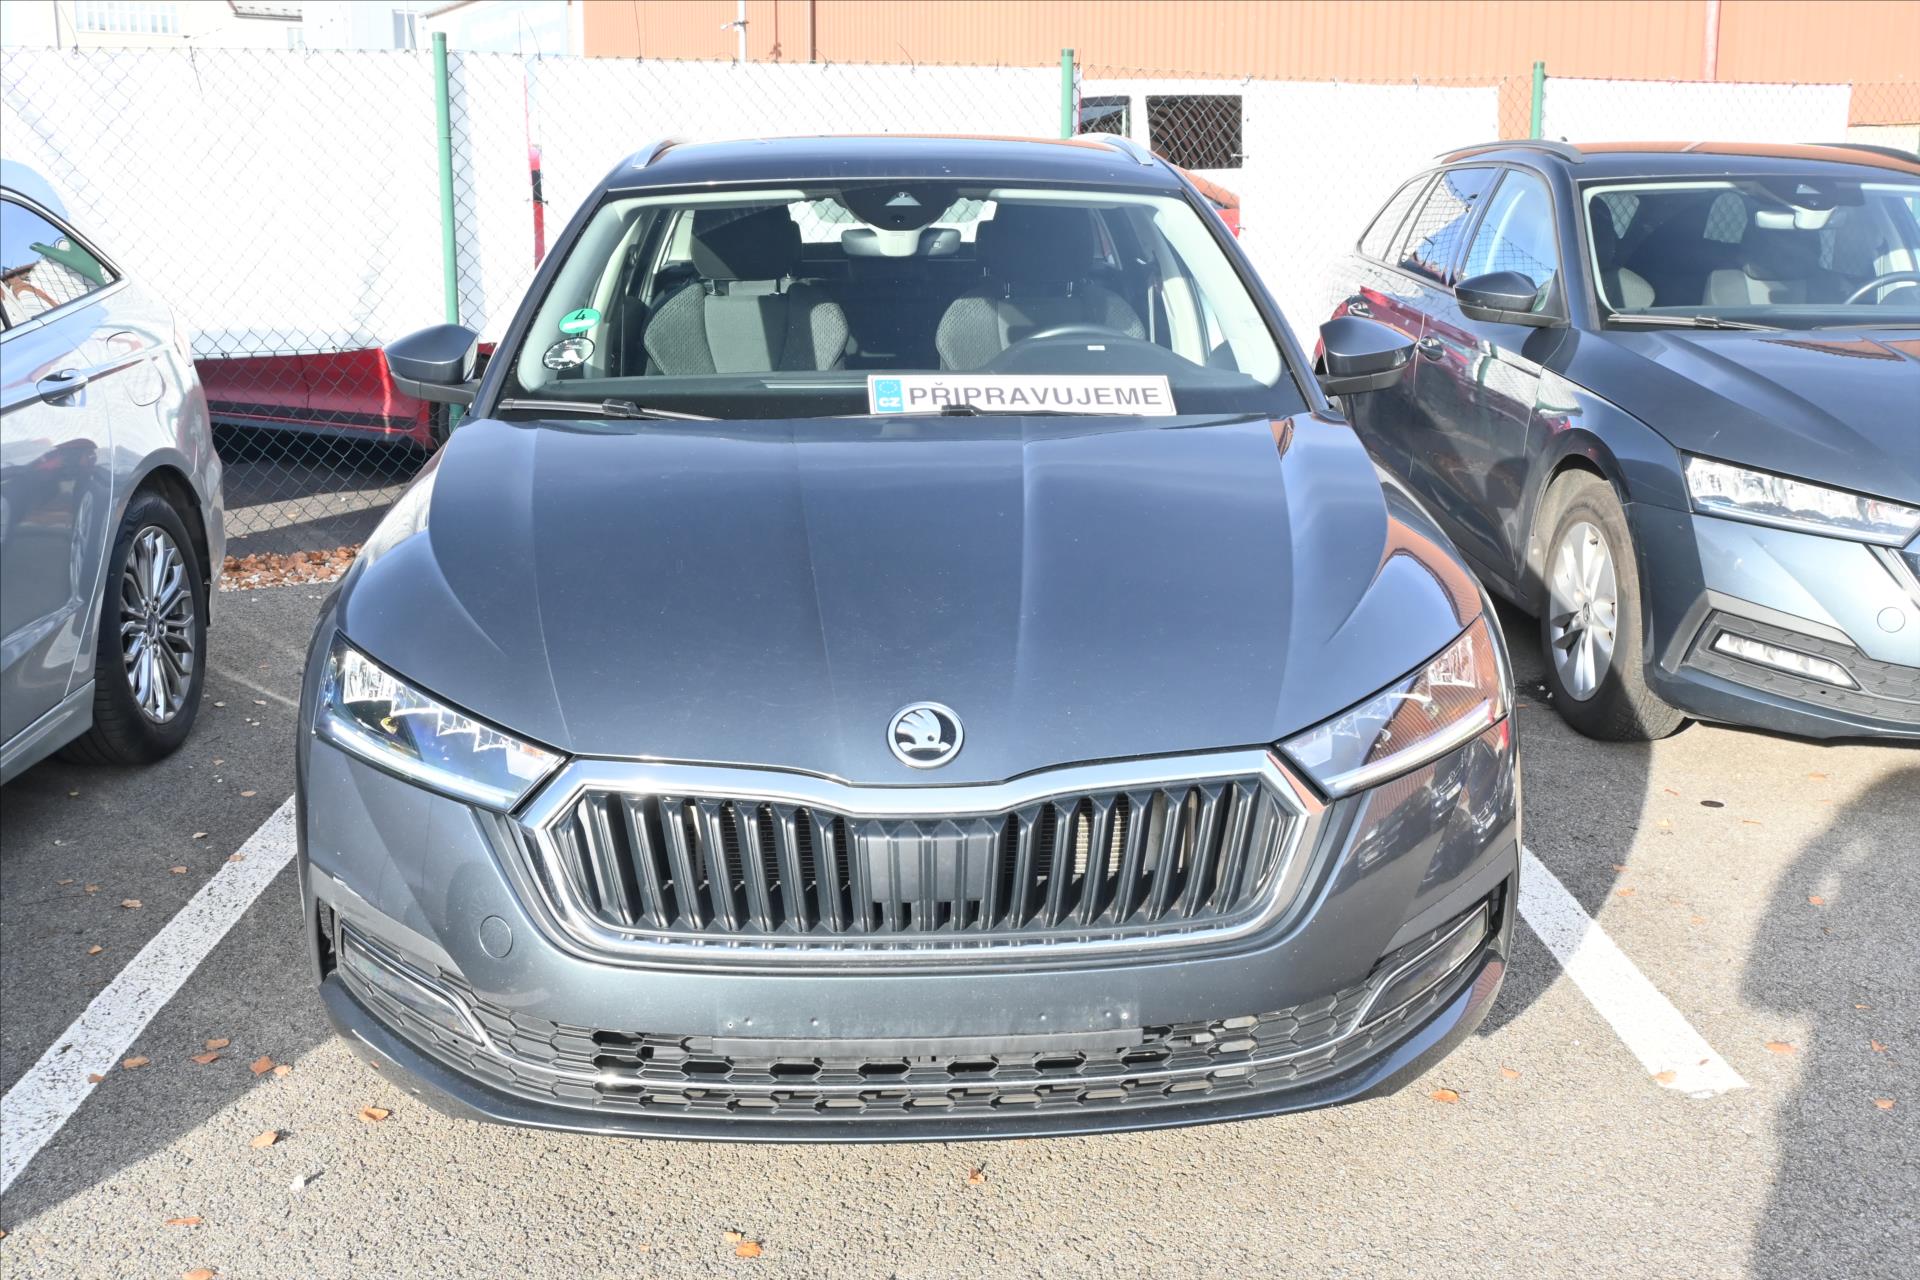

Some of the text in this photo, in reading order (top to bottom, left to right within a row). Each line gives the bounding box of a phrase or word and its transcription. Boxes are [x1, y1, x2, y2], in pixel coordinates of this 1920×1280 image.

[574, 309, 586, 320] 4
[909, 382, 1162, 406] PŘIPRAVUJEME
[879, 397, 900, 407] CZ
